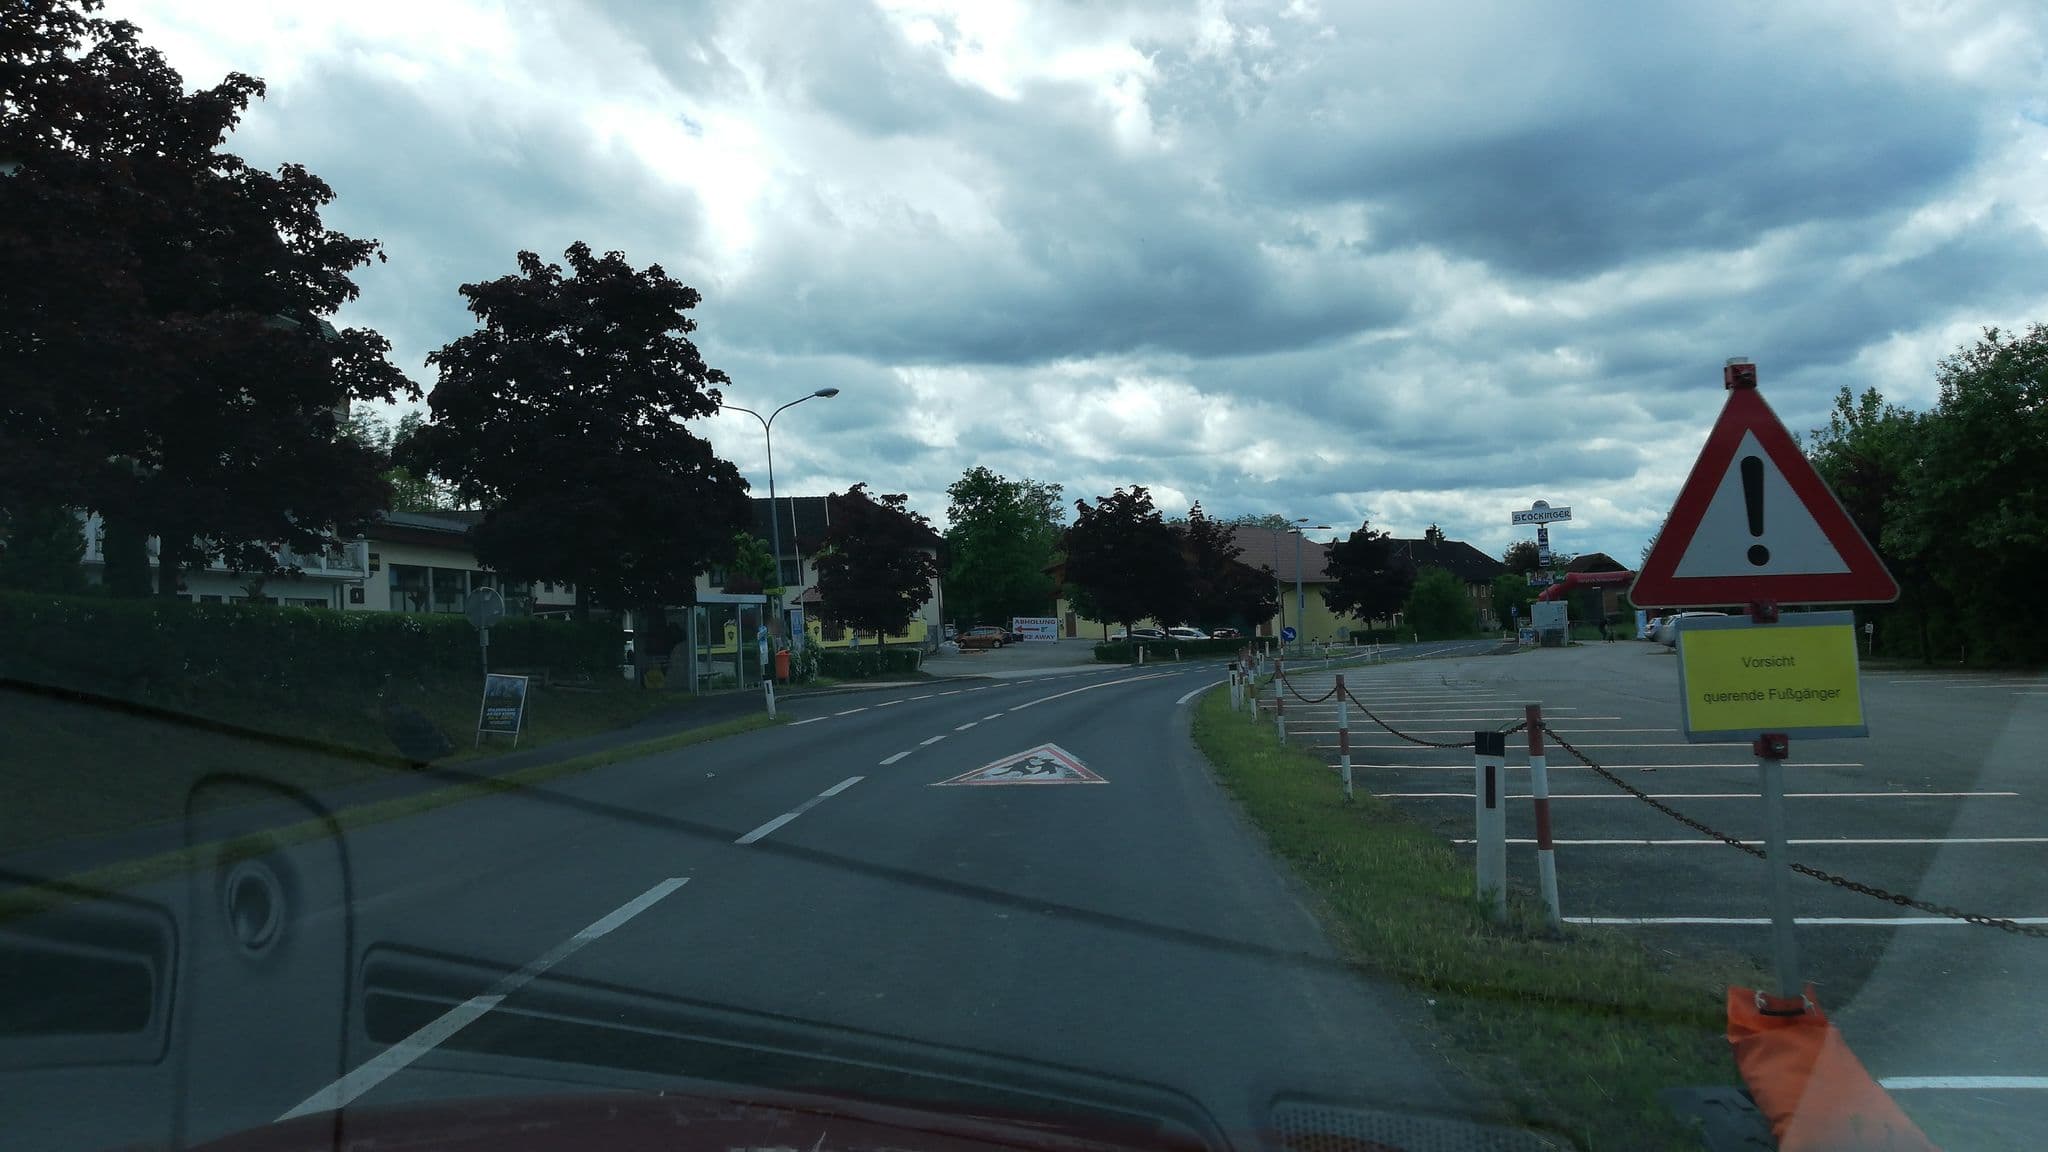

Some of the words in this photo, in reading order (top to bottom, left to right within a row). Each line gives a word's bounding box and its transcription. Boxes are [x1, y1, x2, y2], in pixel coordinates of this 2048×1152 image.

[1742, 656, 1795, 668] Vorsicht
[1703, 689, 1765, 704] querende
[1769, 688, 1841, 703] Fußgänger
